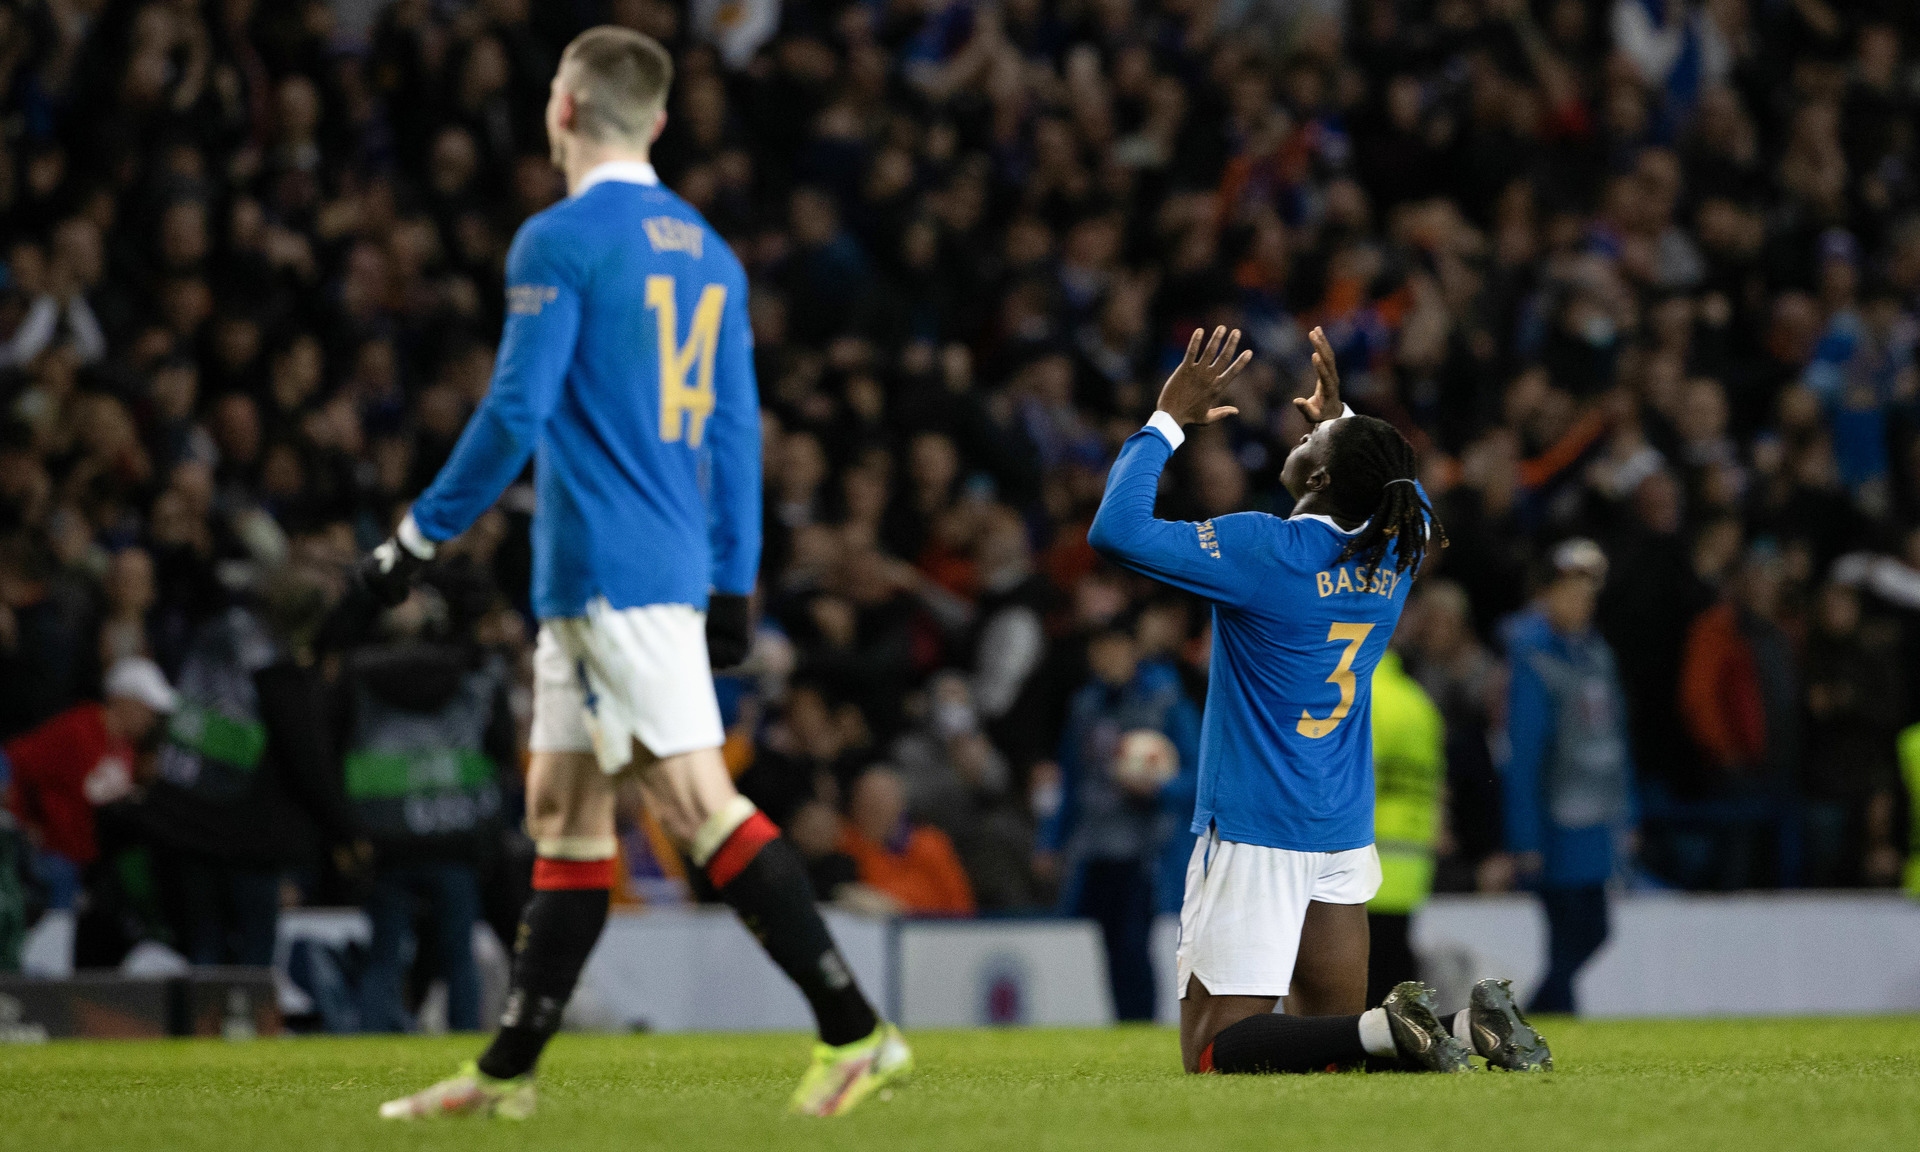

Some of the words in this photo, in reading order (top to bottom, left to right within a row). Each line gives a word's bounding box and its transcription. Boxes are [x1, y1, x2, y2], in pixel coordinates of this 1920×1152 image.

[645, 274, 727, 448] 14
[1204, 519, 1221, 559] MKET
[1316, 566, 1401, 599] BASSEY
[1296, 622, 1376, 738] 3
